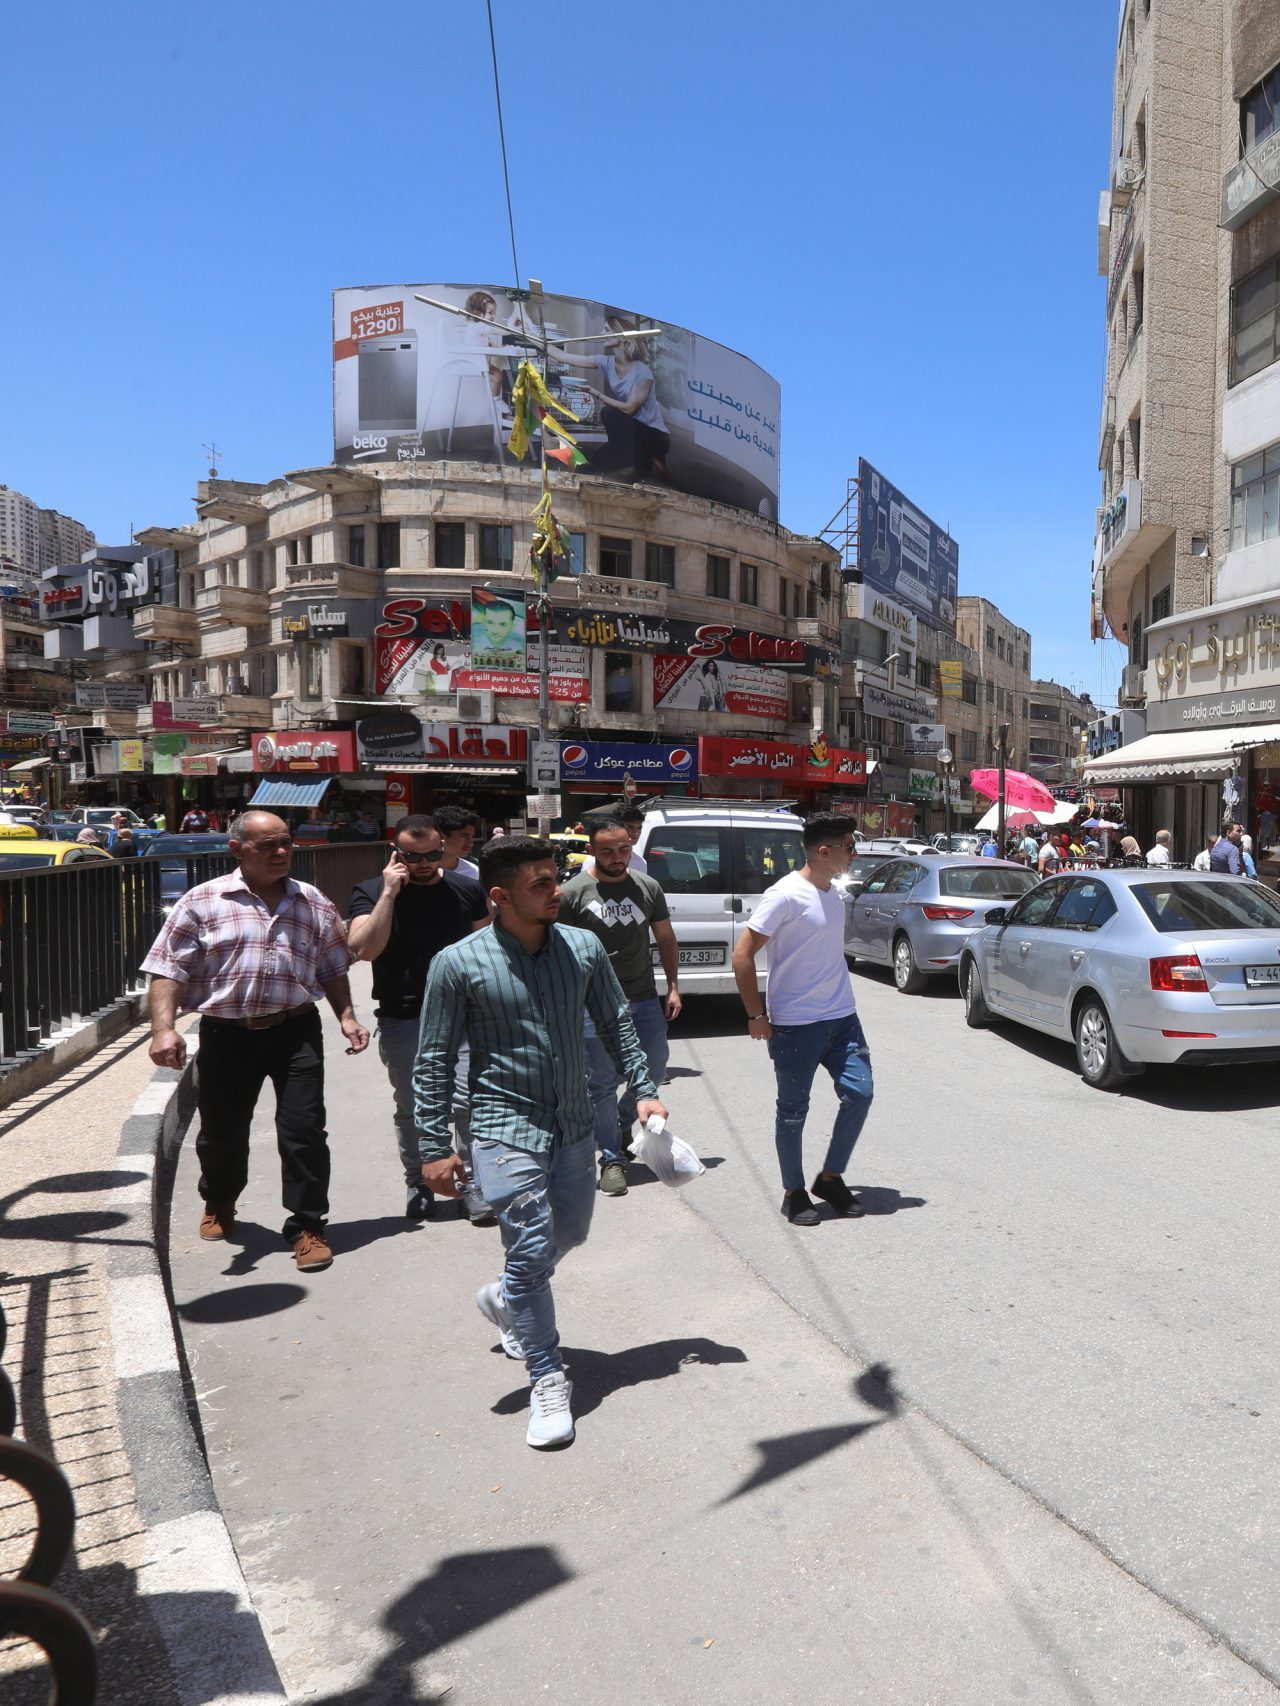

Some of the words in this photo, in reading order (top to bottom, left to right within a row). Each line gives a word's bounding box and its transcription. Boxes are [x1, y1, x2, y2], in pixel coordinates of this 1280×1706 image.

[358, 317, 397, 338] 1290
[687, 380, 743, 412] محبتك
[687, 408, 732, 432] قلبك
[744, 402, 761, 421] عن
[352, 434, 388, 449] beko
[734, 424, 751, 443] من
[397, 447, 410, 461] يوم
[411, 447, 426, 459] لكل
[687, 623, 806, 660] Selena
[1208, 699, 1246, 721] البرقاوي
[1247, 699, 1277, 716] يوسف
[425, 727, 528, 761] العقاد
[593, 756, 625, 769] عوكل
[627, 758, 664, 769] مطاعم
[728, 747, 768, 768] الأخضر
[770, 752, 794, 770] التل
[564, 769, 587, 777] pepsi
[670, 771, 690, 779] pepsi
